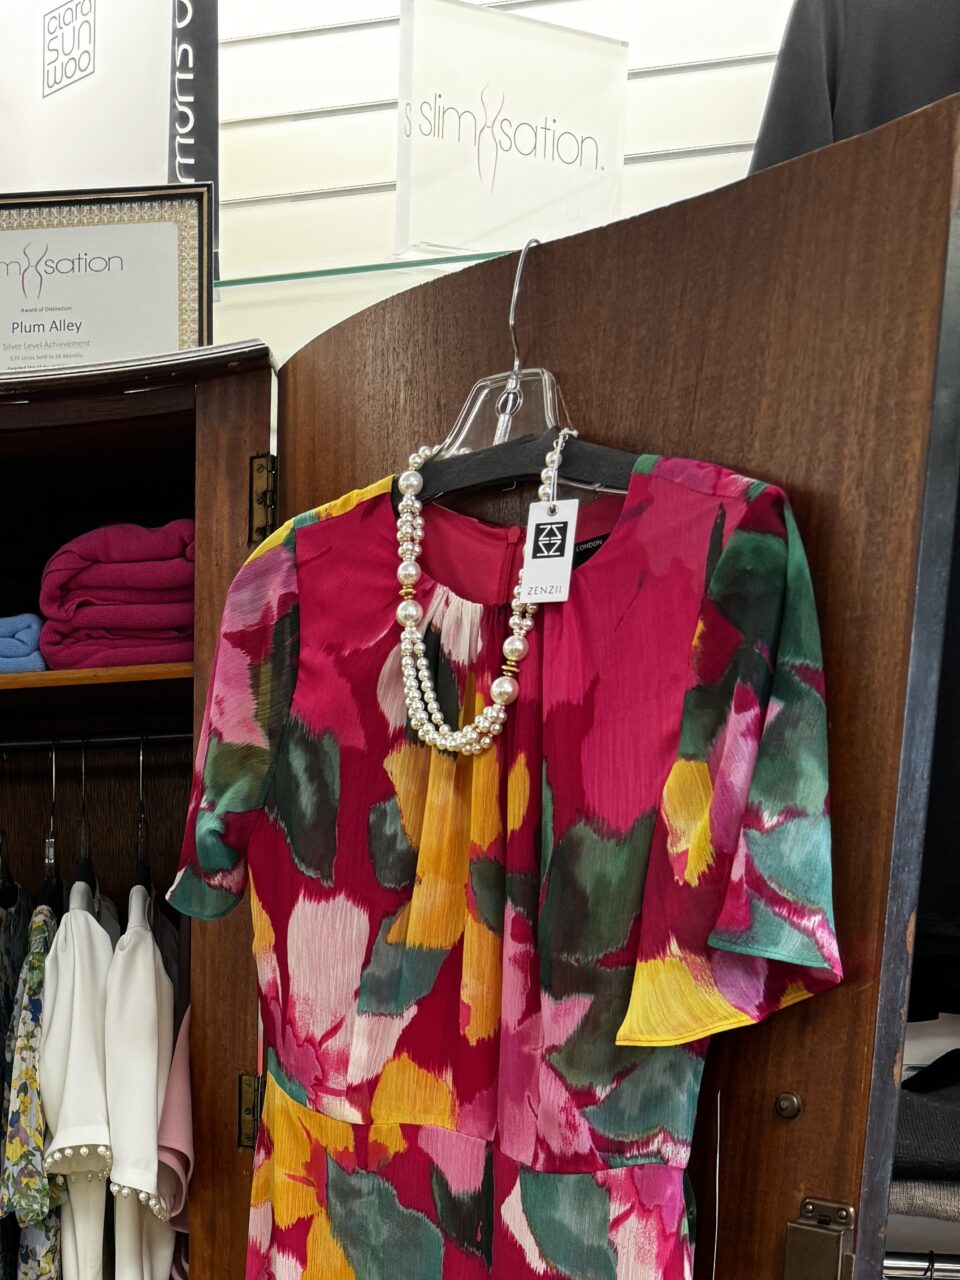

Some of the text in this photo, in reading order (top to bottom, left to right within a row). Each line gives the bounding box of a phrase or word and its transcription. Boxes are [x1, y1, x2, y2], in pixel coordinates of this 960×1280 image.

[11, 318, 83, 334] Plum Alley
[2, 339, 91, 352] Silver Level Achievement
[62, 351, 84, 359] Months
[575, 539, 603, 552] LONDON
[527, 584, 563, 596] ZENZII
